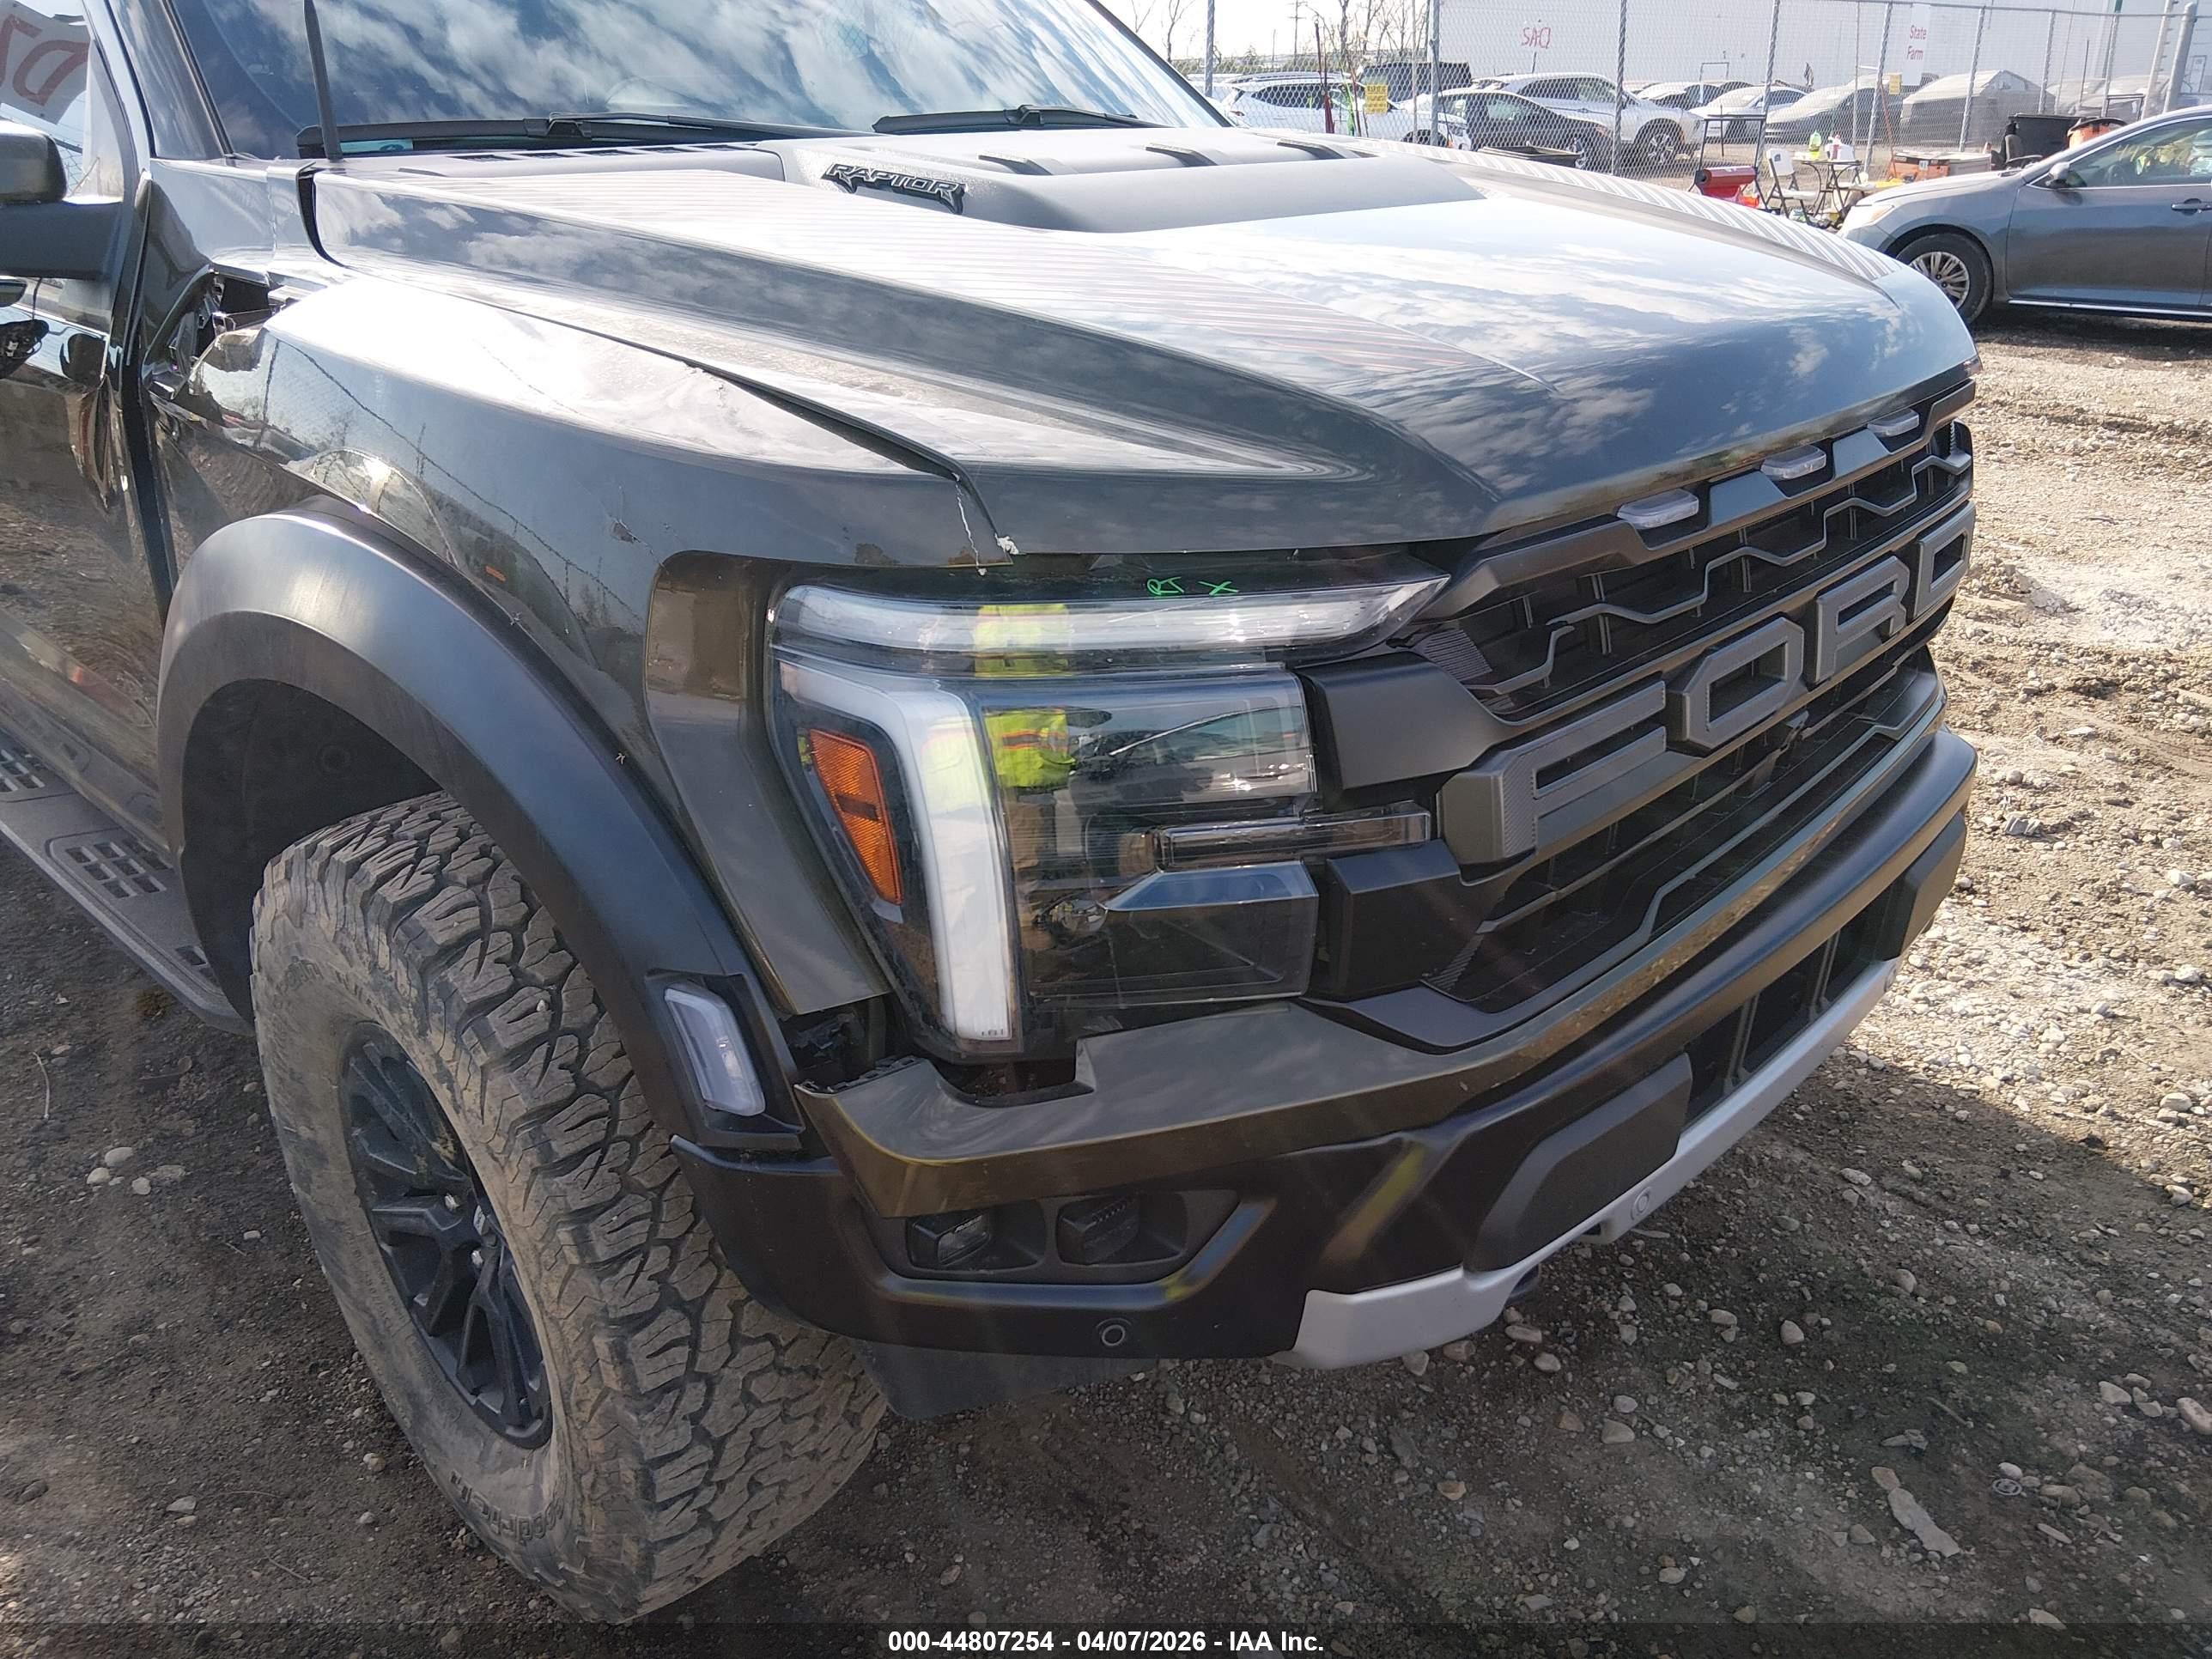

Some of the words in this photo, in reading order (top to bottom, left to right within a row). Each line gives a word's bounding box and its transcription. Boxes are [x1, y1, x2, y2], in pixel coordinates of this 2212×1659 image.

[1909, 24, 1928, 40] State
[1906, 45, 1924, 61] Farm
[824, 163, 965, 212] RAPTOR
[1197, 580, 1239, 596] X
[1444, 501, 1976, 862] FORD
